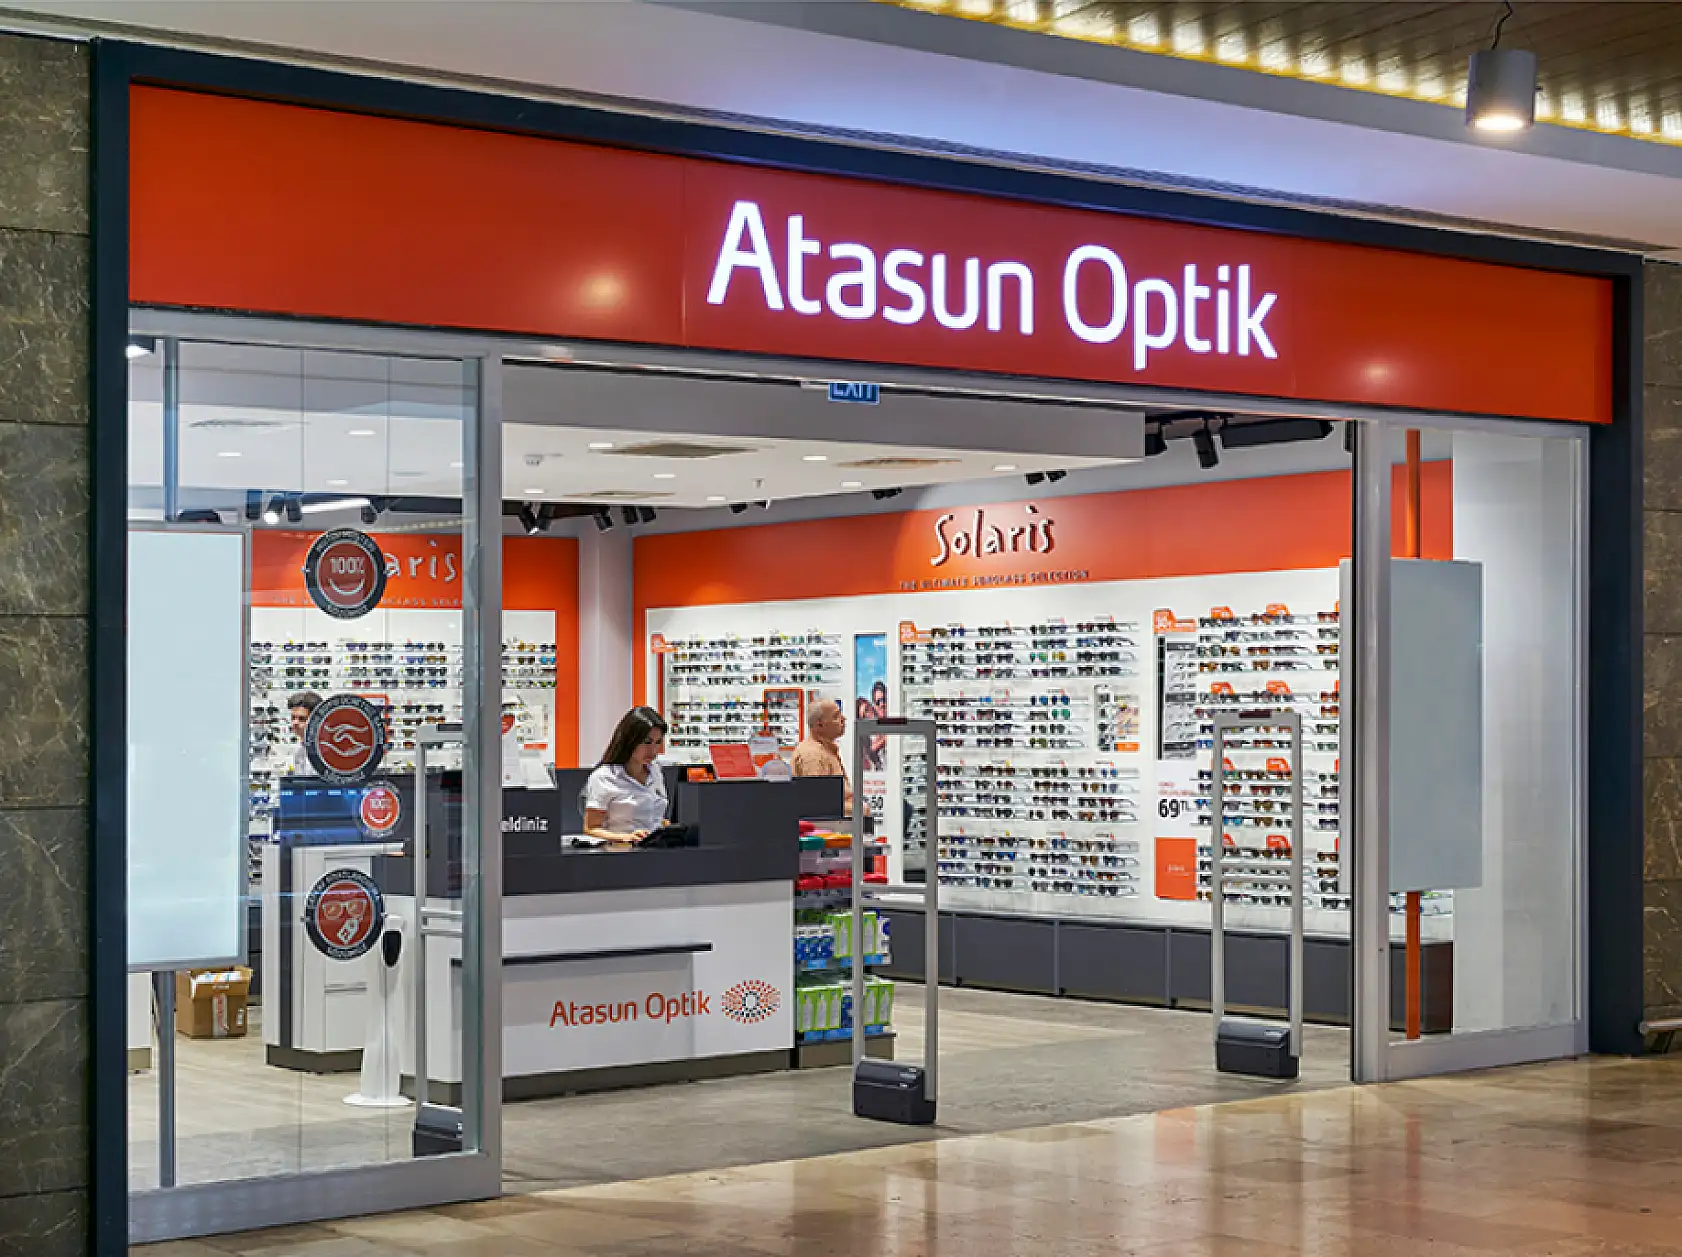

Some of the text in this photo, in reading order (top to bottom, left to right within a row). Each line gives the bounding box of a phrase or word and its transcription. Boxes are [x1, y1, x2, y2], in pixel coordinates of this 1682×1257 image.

[706, 200, 1279, 371] Atasun Optik
[832, 382, 874, 400] EXIT
[930, 503, 1055, 567] Solaris
[550, 991, 711, 1028] Atasun Optik
